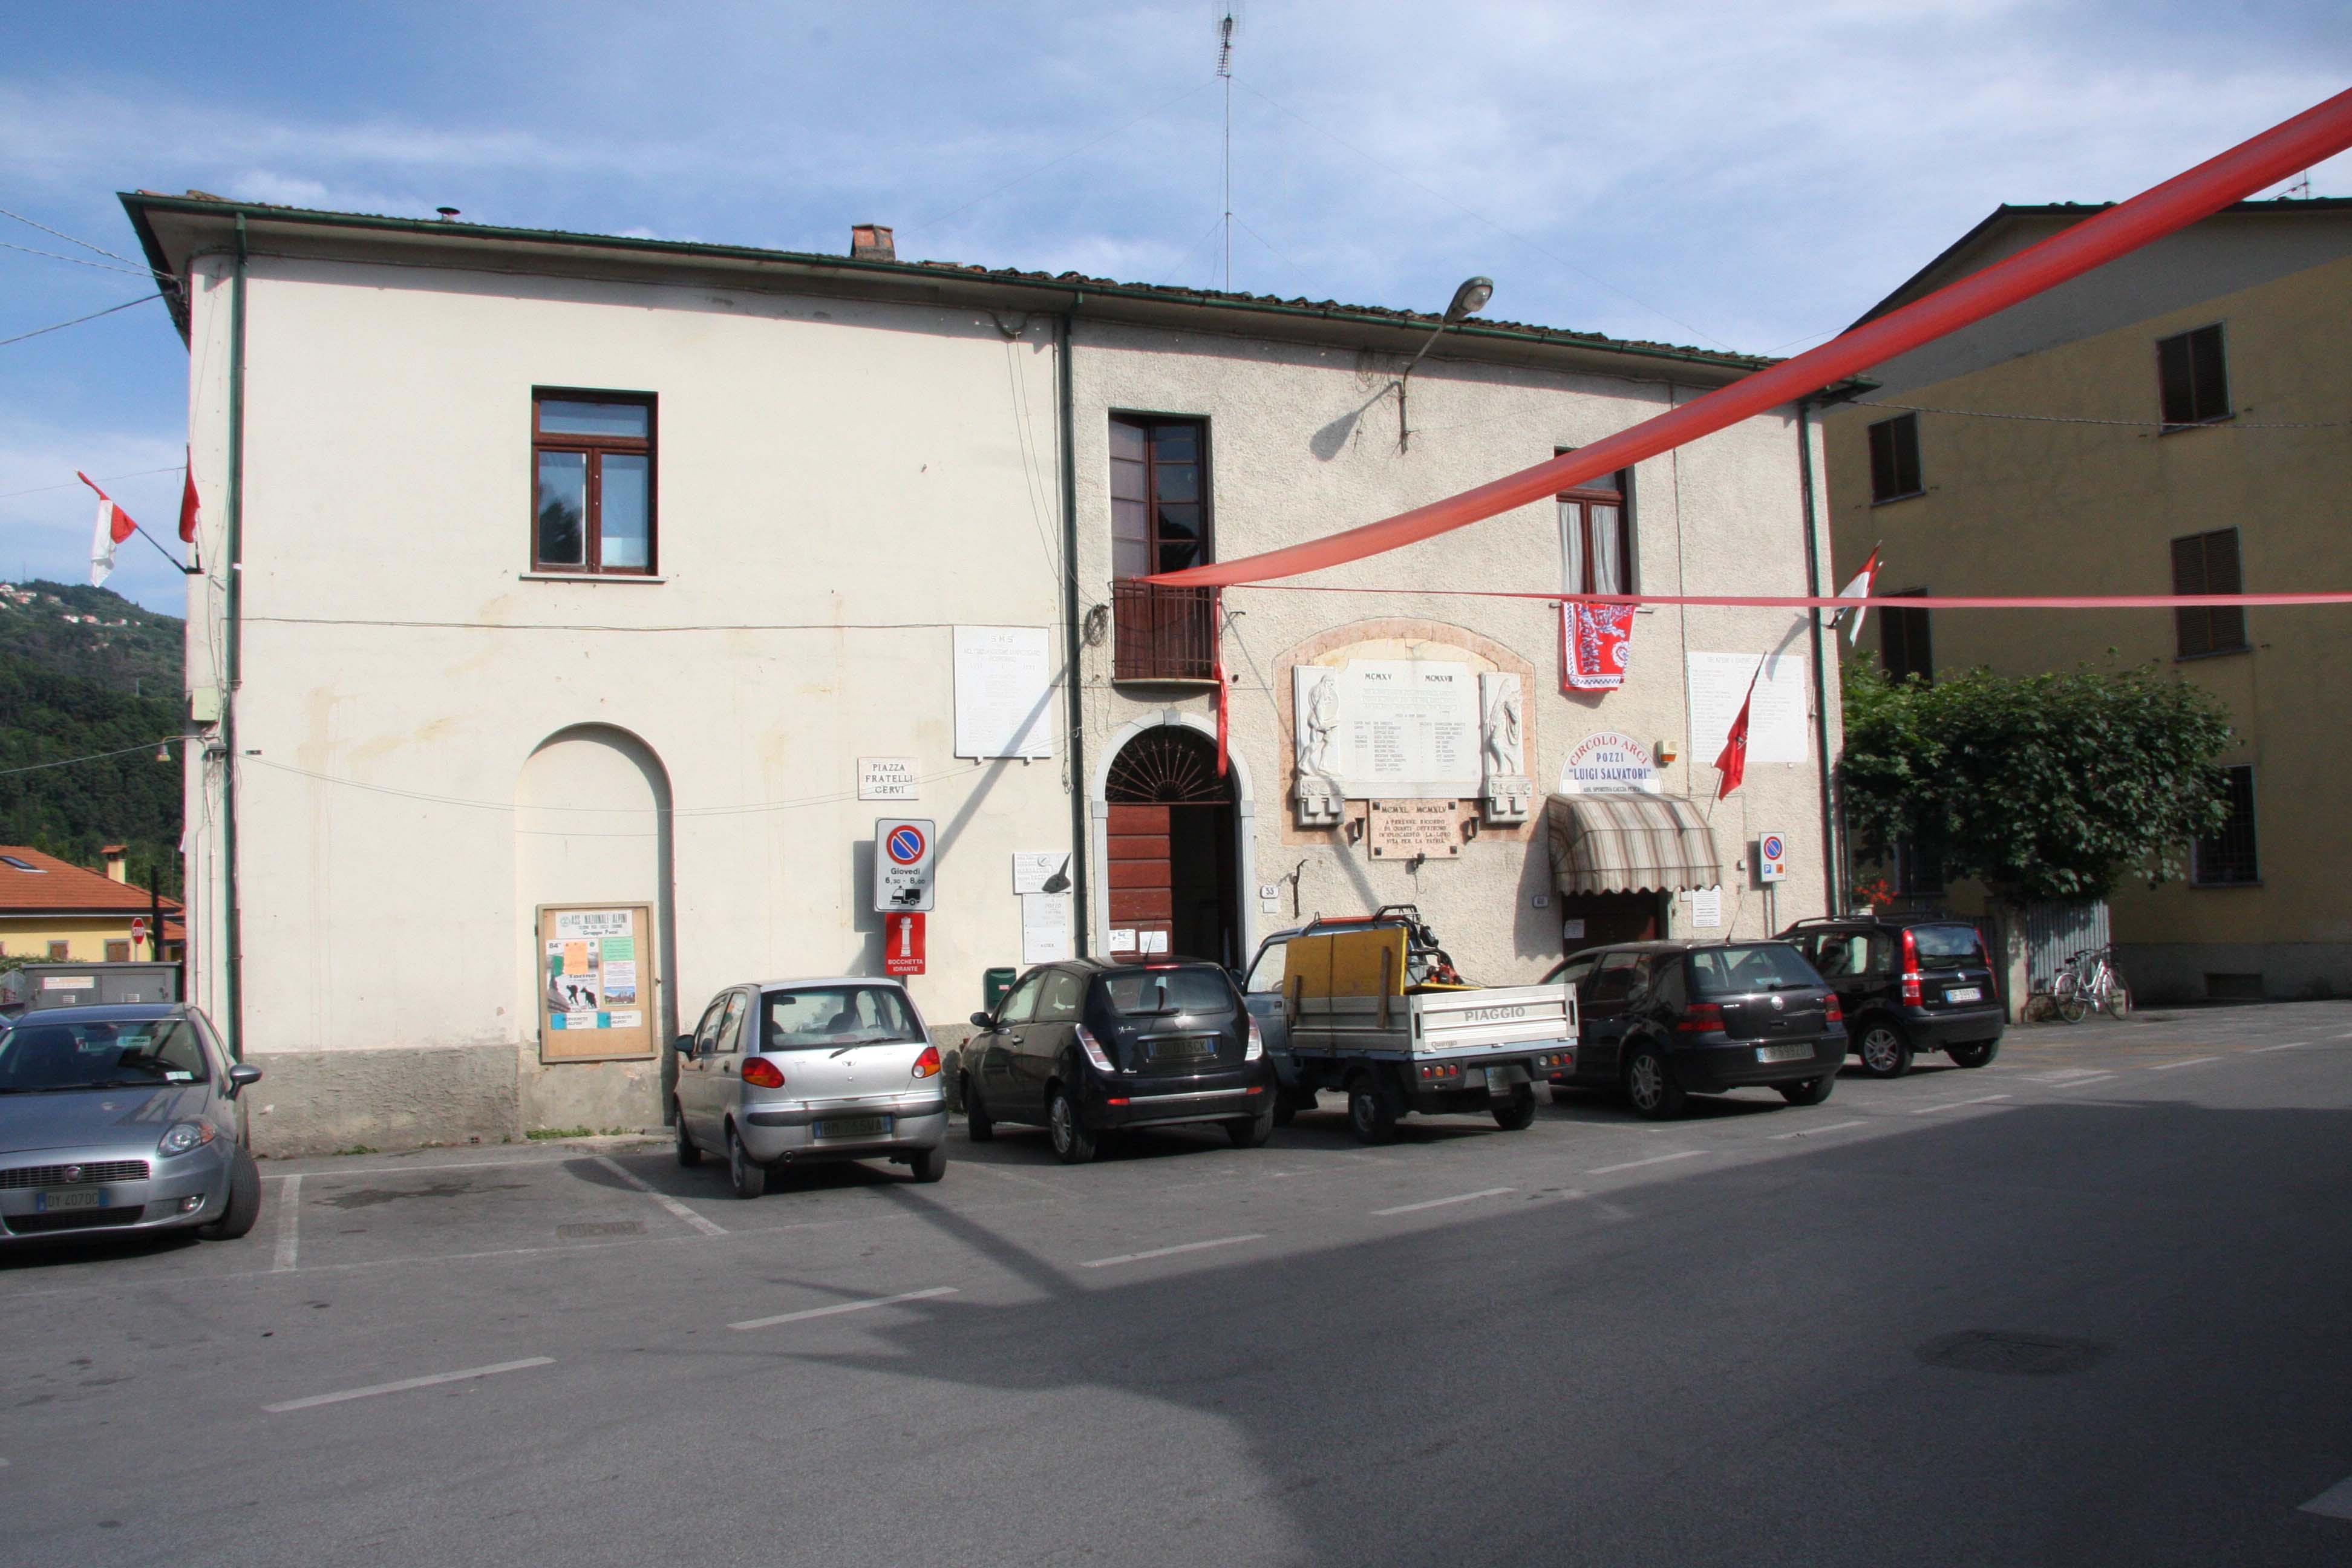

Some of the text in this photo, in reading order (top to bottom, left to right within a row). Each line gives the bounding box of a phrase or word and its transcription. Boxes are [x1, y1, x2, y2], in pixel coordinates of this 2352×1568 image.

[1570, 736, 1648, 766] CIRCOLO ARCI
[1596, 753, 1624, 762] POZZI
[613, 913, 627, 923] ALPINI
[132, 927, 145, 936] STOP
[1465, 1007, 1526, 1022] PIAGGIO
